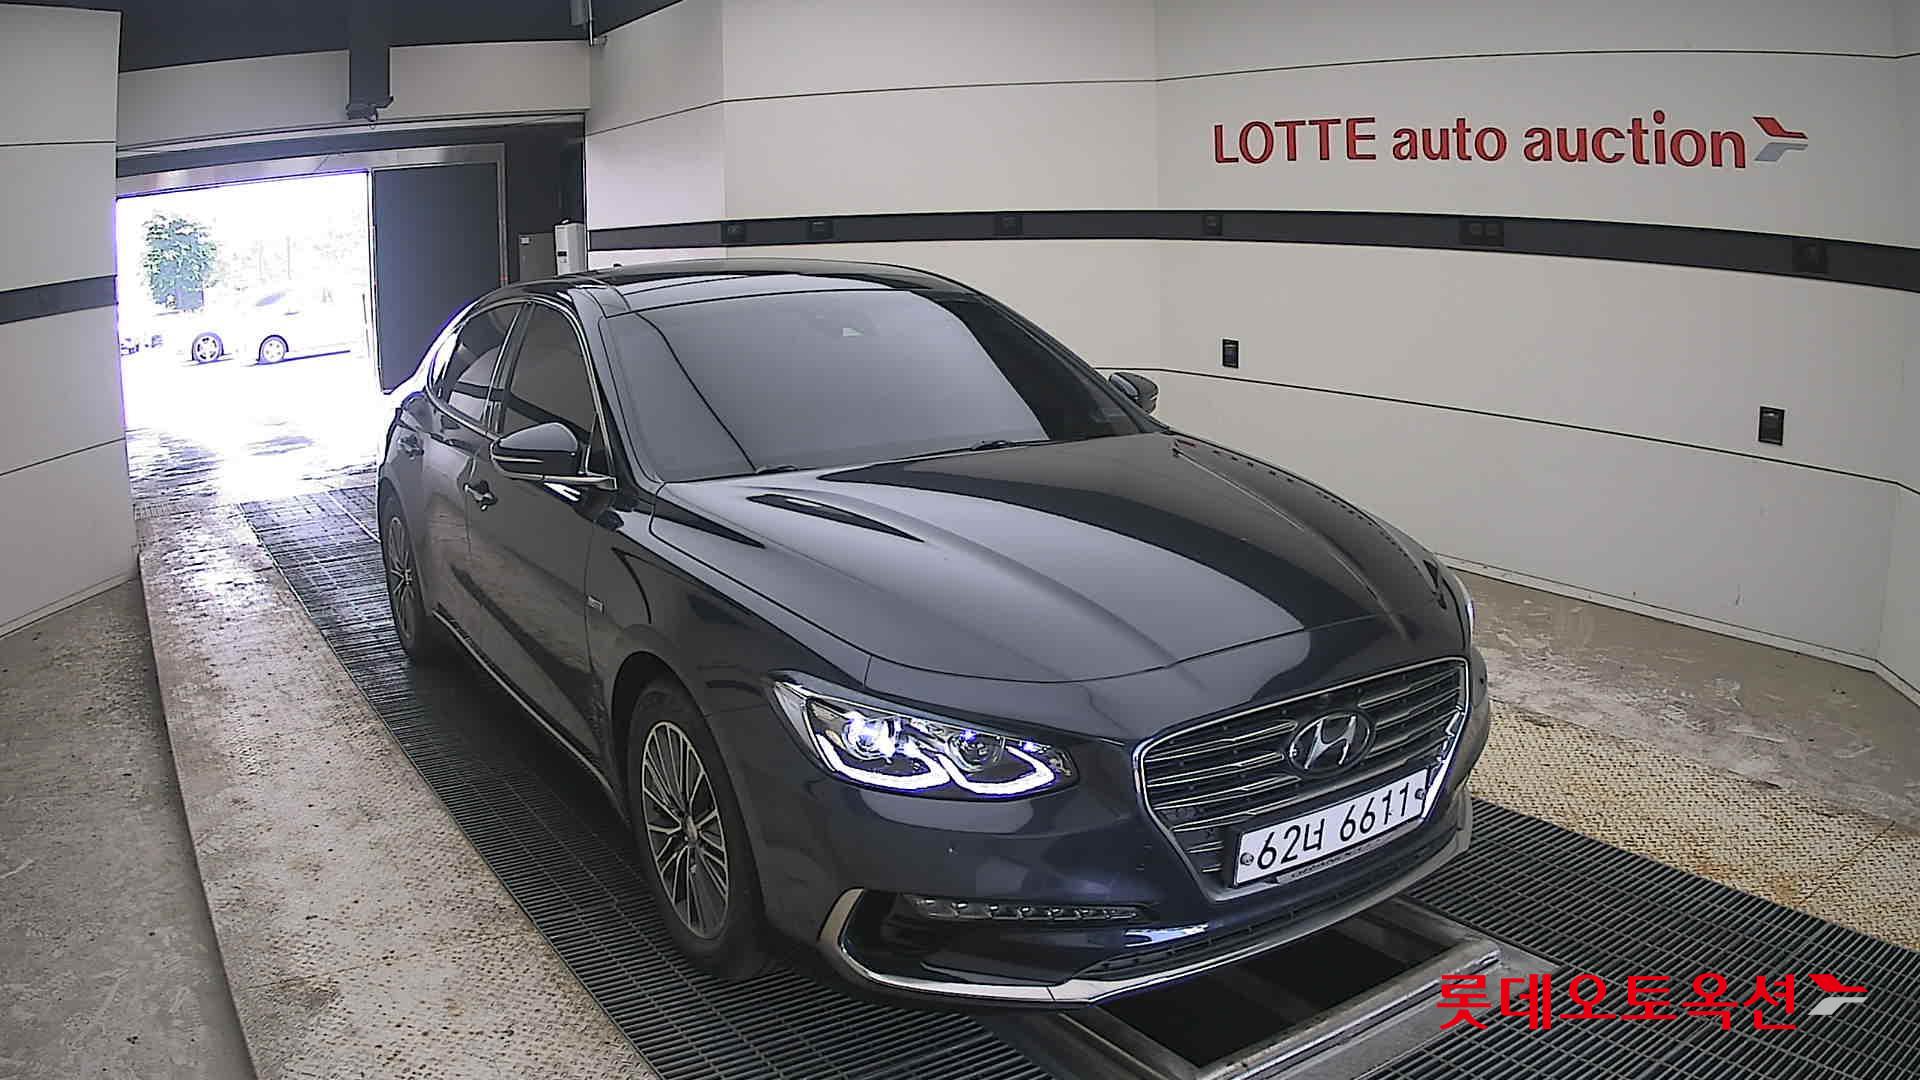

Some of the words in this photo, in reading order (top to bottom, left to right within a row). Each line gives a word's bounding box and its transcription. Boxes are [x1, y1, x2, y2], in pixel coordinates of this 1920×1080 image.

[1213, 117, 1377, 164] LOTTE
[1392, 117, 1508, 162] auto
[1523, 110, 1746, 169] auction
[1257, 818, 1325, 870] 62너
[1340, 782, 1410, 842] 6611
